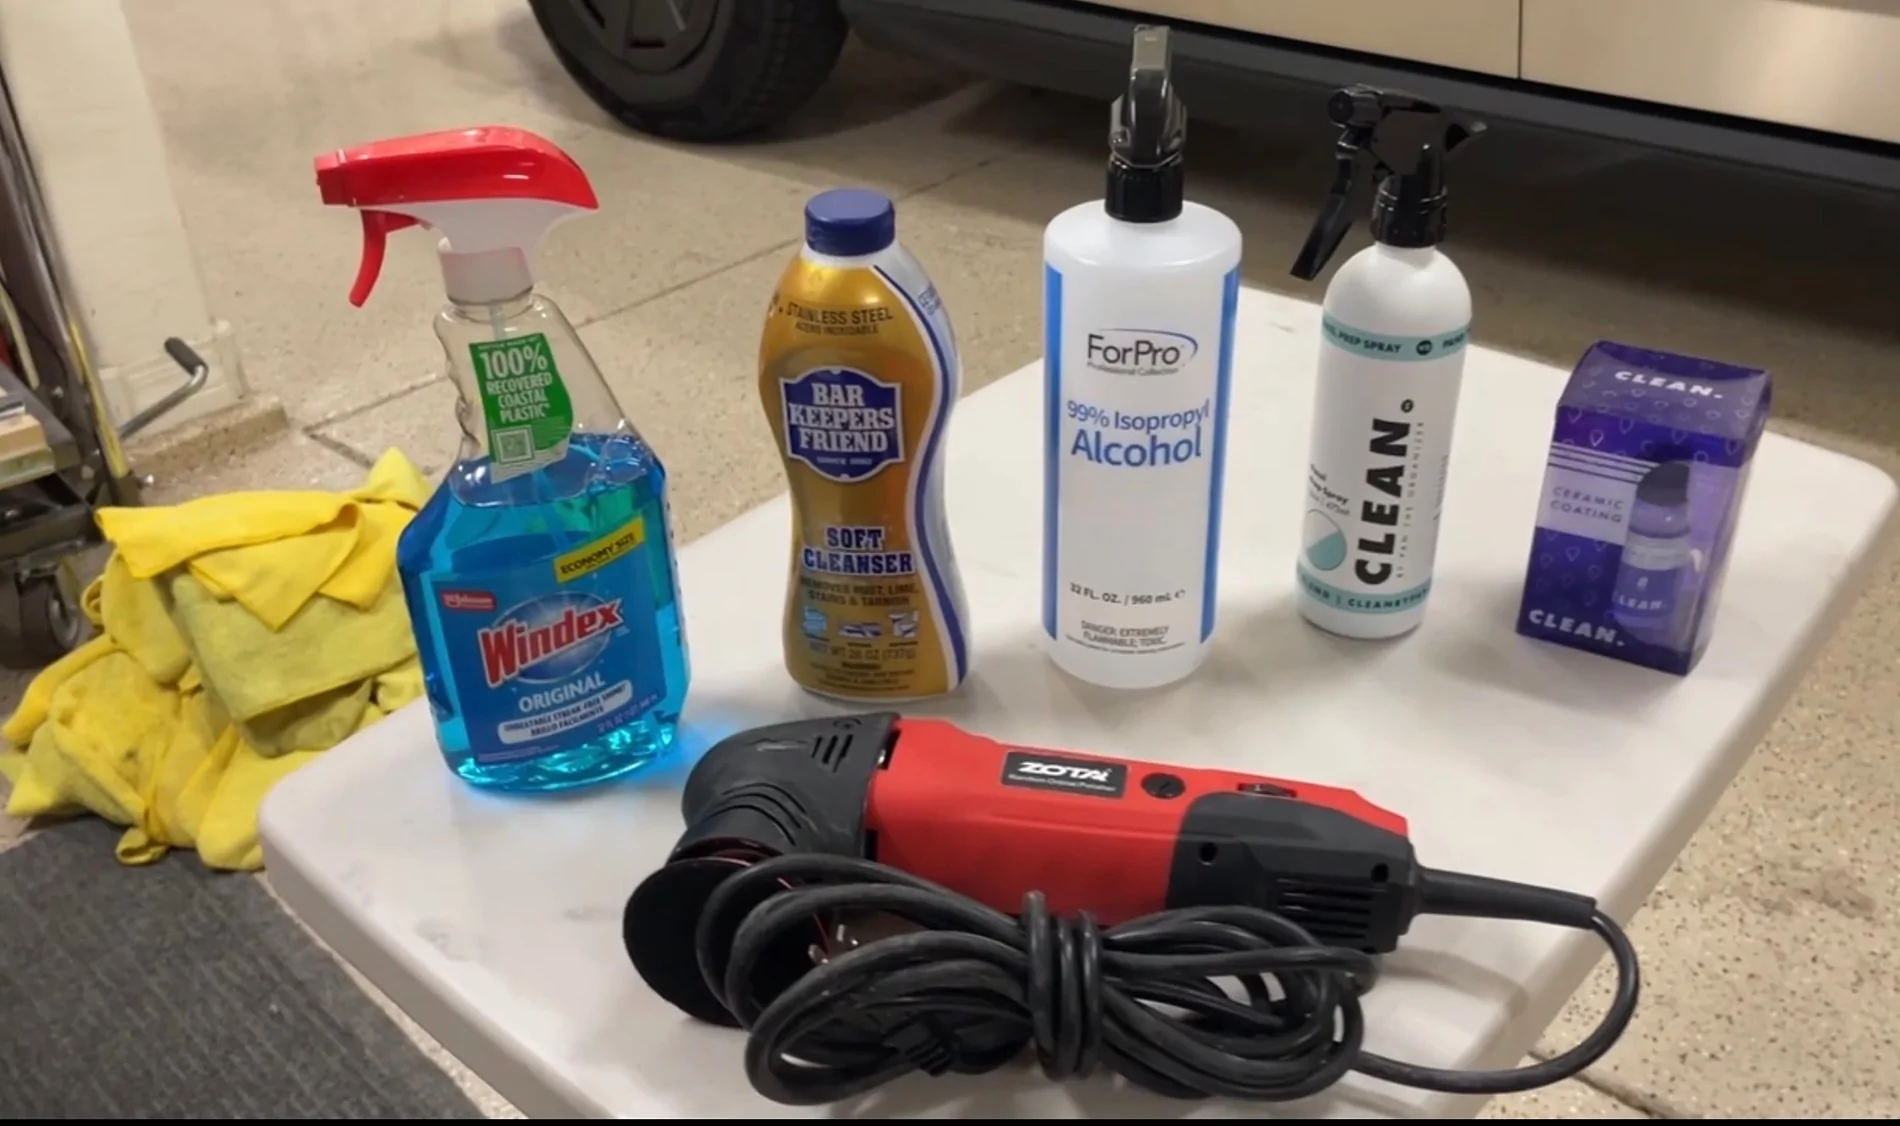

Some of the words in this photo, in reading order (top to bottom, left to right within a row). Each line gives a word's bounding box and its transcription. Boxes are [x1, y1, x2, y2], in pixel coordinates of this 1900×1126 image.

[786, 301, 847, 325] STAINLESS
[852, 307, 893, 325] STEEL
[1088, 333, 1181, 366] ForPro
[1364, 339, 1402, 353] SPRAY
[479, 342, 548, 380] 100%
[486, 372, 553, 395] RECOVERED
[811, 383, 865, 406] BAR
[1615, 371, 1723, 399] CLEAN.
[498, 389, 549, 410] COASTAL
[788, 403, 895, 431] KEEPERS
[1067, 399, 1110, 428] 99%
[1114, 398, 1210, 434] Isopropyl
[800, 427, 888, 453] FRIEND
[1071, 424, 1202, 467] Alcohol
[1551, 500, 1622, 524] COATING
[1553, 486, 1625, 511] CERAMIC
[826, 526, 884, 549] SOFT
[560, 543, 614, 575] ECONOMY
[614, 532, 635, 548] SIZE
[803, 548, 914, 575] CLEANSER
[1529, 609, 1625, 647] CLEAN.
[477, 599, 625, 688] Windex
[518, 671, 607, 713] ORIGINAL
